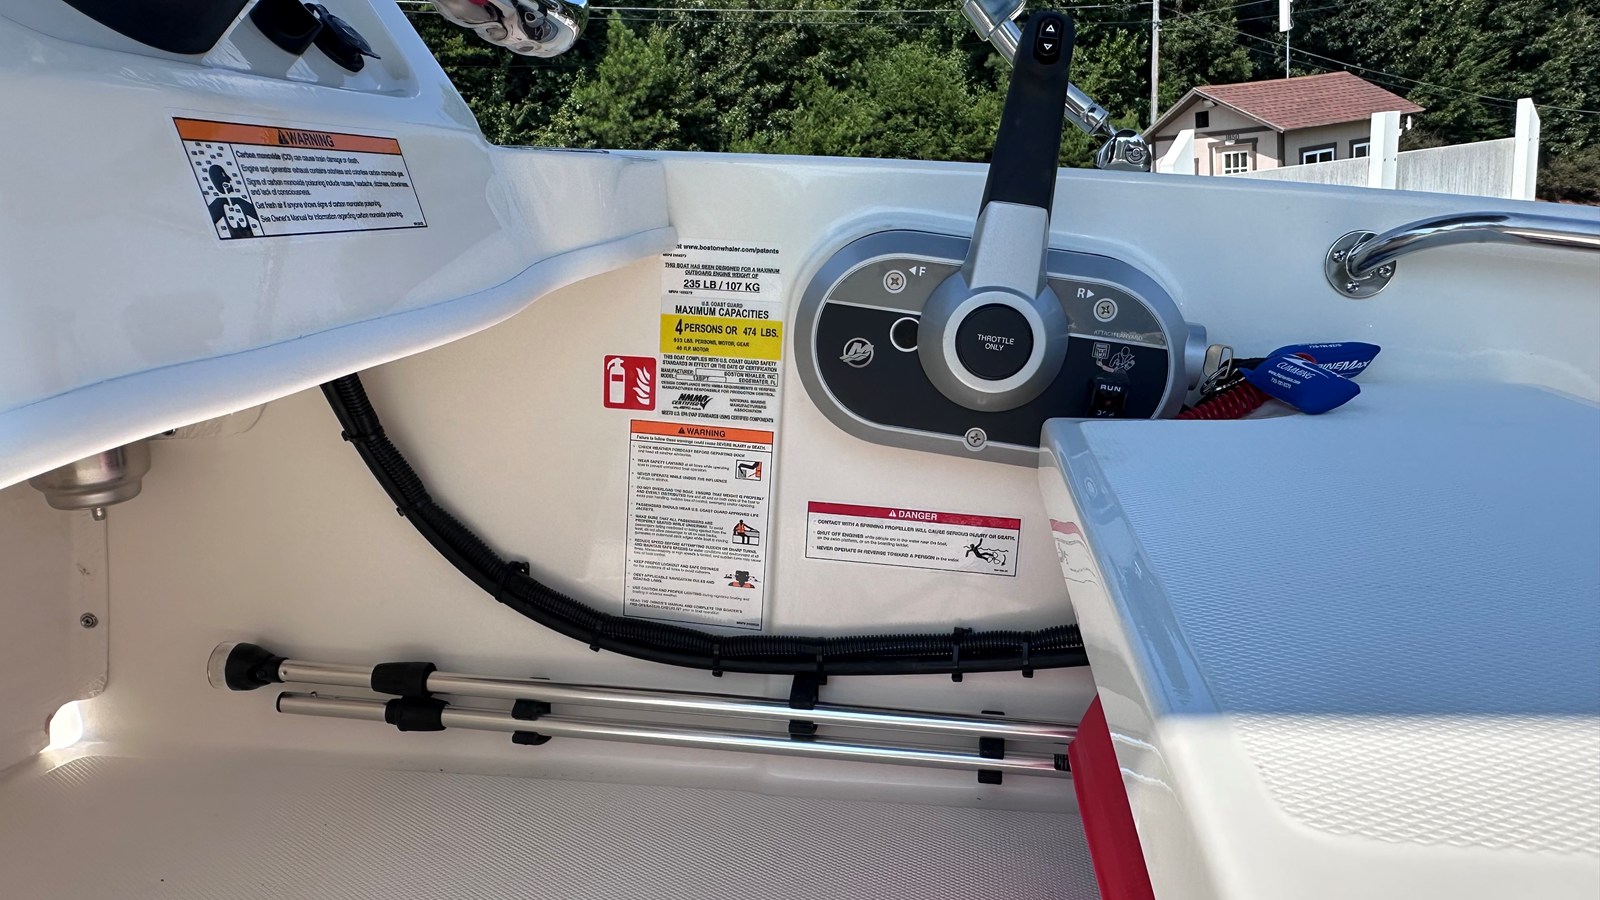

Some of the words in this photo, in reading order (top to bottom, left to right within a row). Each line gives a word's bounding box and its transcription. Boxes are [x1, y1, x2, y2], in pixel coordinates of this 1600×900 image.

[286, 131, 335, 147] WARNING
[683, 244, 779, 254] www.bostonwhaler.com/patents
[919, 266, 926, 277] F
[684, 279, 700, 288] 235
[703, 280, 717, 289] LB
[718, 281, 723, 290] /
[726, 282, 742, 291] 107
[745, 283, 760, 292] KG
[1076, 288, 1086, 298] R
[675, 305, 716, 316] MAXIMUM
[718, 308, 769, 319] CAPACITIES
[675, 319, 683, 335] 4
[684, 323, 722, 334] PERSONS
[725, 326, 738, 335] OR
[743, 327, 756, 336] 474
[760, 328, 779, 338] LBS.
[978, 333, 1015, 345] THROTTLE
[985, 342, 1004, 351] ONLY
[1276, 362, 1316, 379] CUMMING
[1100, 384, 1121, 392] RUN
[687, 427, 726, 438] WARNING
[898, 510, 938, 520] DANGER
